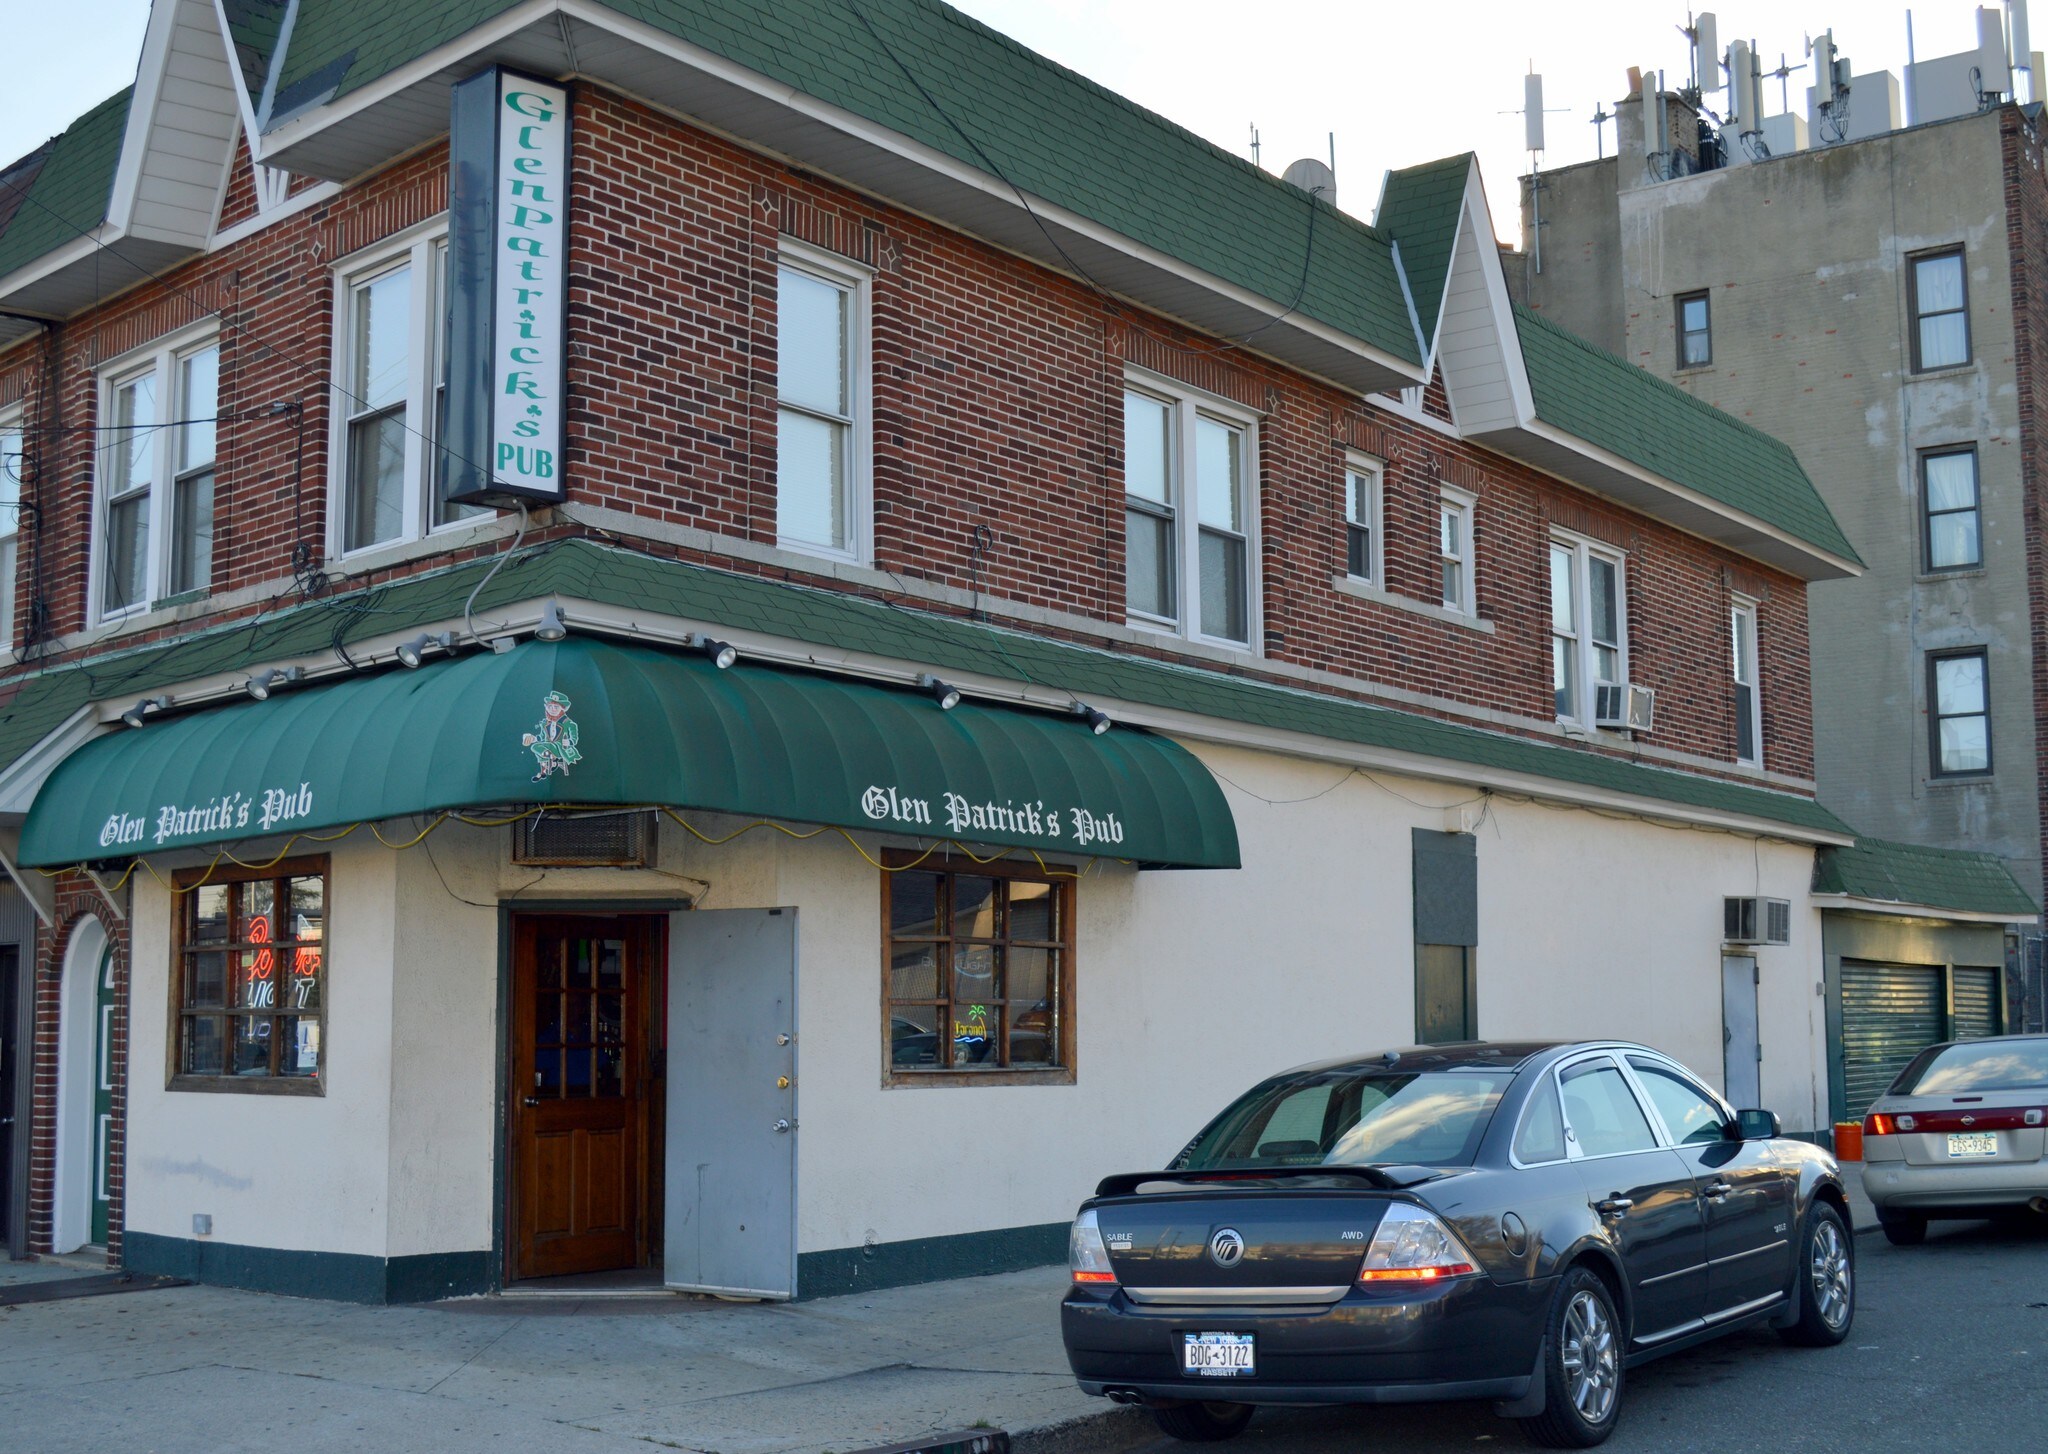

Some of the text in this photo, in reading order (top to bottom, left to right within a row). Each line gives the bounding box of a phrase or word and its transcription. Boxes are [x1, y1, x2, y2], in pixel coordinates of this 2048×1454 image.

[497, 441, 554, 479] PUB
[99, 781, 313, 847] Glen Patrick's Pub
[860, 784, 1124, 846] Glen Patrick's Pub
[1106, 1232, 1133, 1241] SABLE
[1341, 1231, 1364, 1240] AWD
[1200, 1368, 1238, 1376] HASSETT
